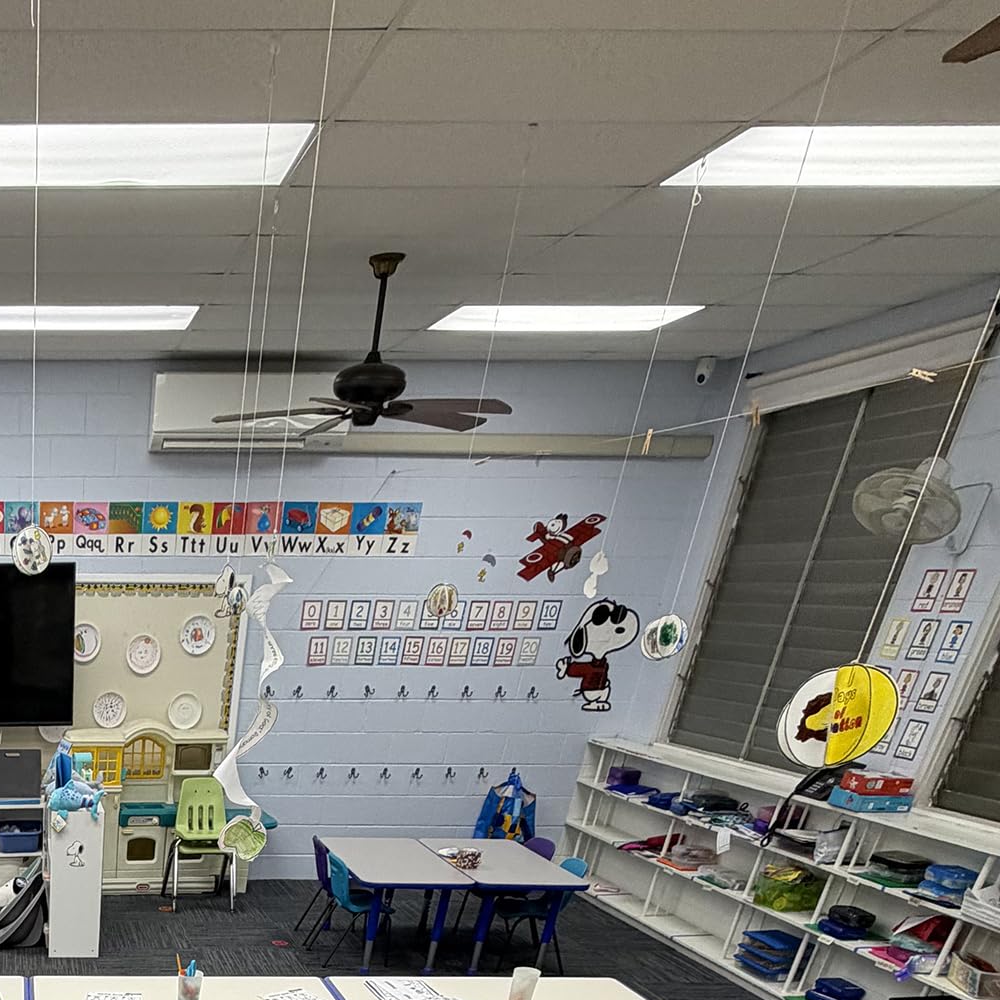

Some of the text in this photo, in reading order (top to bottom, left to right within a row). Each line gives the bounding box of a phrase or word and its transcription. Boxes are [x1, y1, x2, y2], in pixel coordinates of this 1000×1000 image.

[115, 536, 135, 553] Rr
[149, 536, 168, 553] Ss
[216, 536, 239, 553] Uu
[281, 536, 312, 553] Ww
[356, 535, 375, 555] Yy
[386, 536, 410, 554] Zz
[307, 604, 317, 618] 0
[333, 604, 340, 618] 1
[355, 605, 364, 618] 2
[380, 605, 389, 618] 3
[403, 605, 411, 617] 4
[475, 605, 484, 618] 7
[497, 606, 506, 618] 8
[521, 606, 530, 619] 9
[543, 604, 558, 618] 10
[313, 641, 538, 656] 11 12 13 14 15 16 17 18 19 20
[833, 706, 848, 720] of
